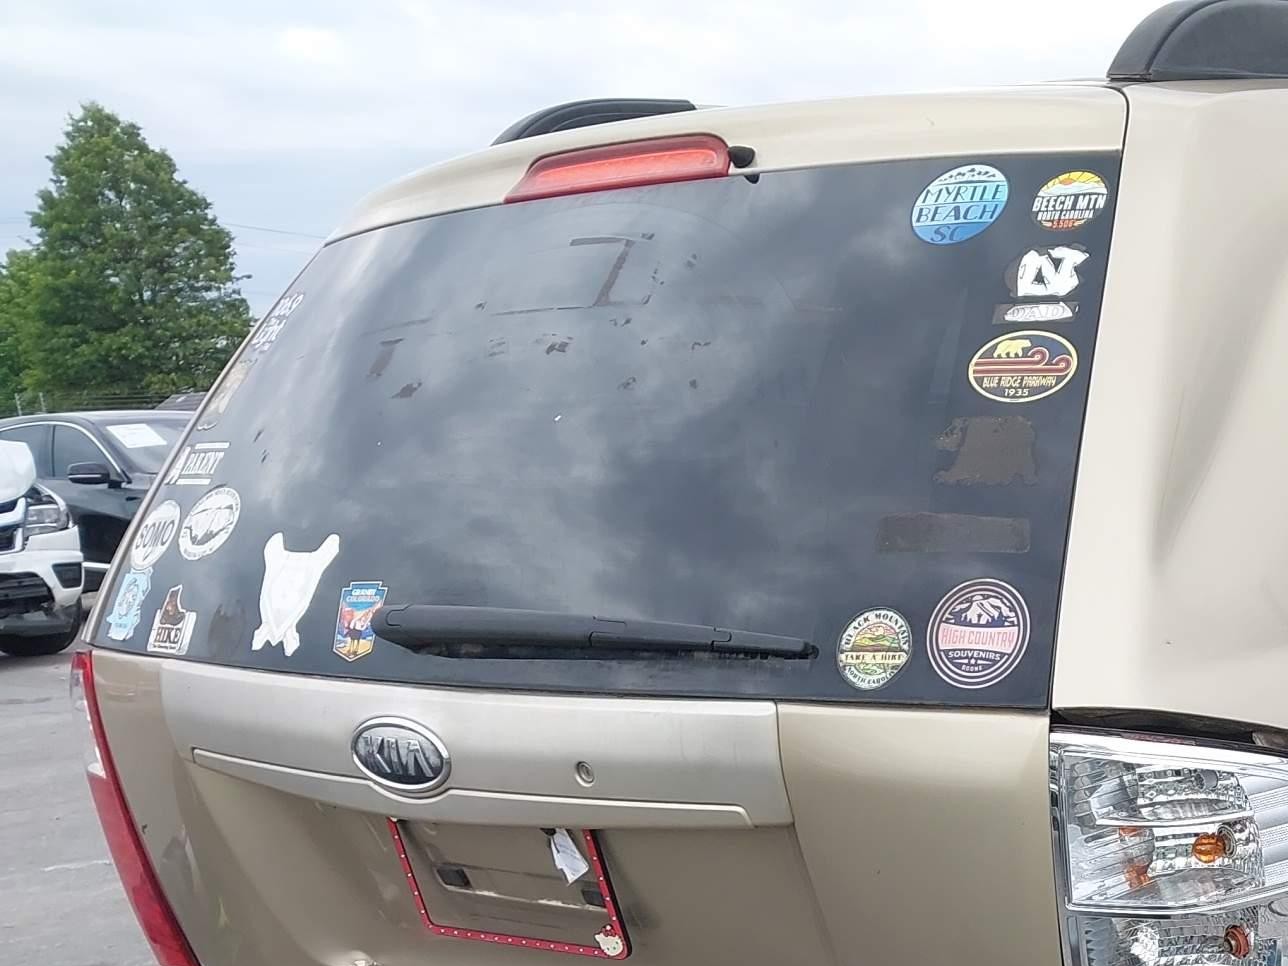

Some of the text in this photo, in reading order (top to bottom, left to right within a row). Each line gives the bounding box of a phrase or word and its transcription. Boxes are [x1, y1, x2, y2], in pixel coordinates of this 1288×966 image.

[922, 184, 1006, 203] MYRTLE
[1032, 194, 1107, 211] BEECH MTN
[916, 204, 999, 223] BEACH
[1037, 210, 1095, 220] NORTH CAROLINA
[931, 226, 966, 242] SC
[983, 375, 1057, 387] BLUE RIDGE PARKWAY
[1004, 389, 1029, 397] 1935
[154, 627, 182, 644] HIKE
[942, 627, 1015, 648] HIGH COUNTRY
[871, 653, 877, 661] A
[881, 653, 903, 661] HIKE
[947, 650, 1001, 661] SOUVENIRS
[362, 734, 436, 779] KIA
